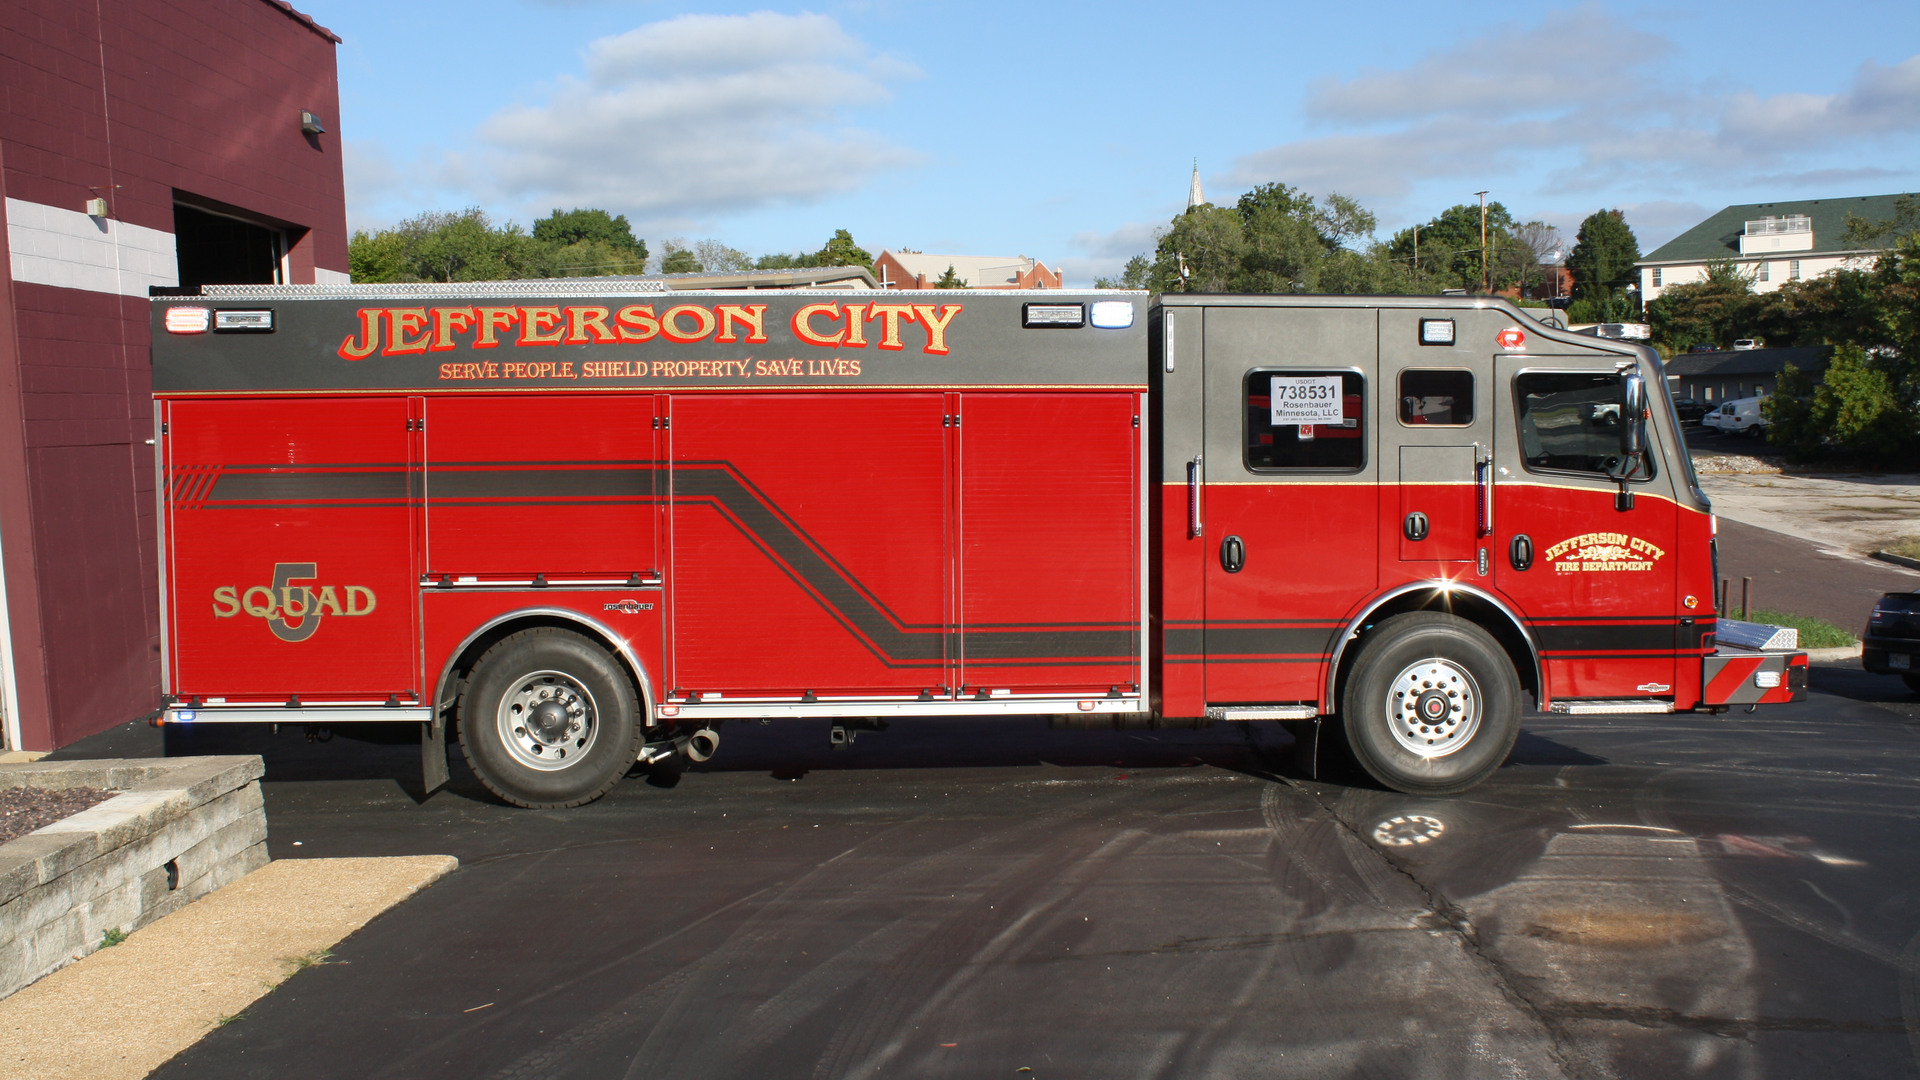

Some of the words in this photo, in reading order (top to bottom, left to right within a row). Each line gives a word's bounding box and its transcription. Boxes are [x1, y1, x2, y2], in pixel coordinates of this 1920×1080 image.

[338, 304, 768, 361] JEFFERSON
[791, 301, 964, 356] CITY
[438, 360, 499, 380] SERVE
[502, 361, 578, 380] PEOPLE,
[581, 361, 648, 379] SHIELD
[650, 359, 751, 379] PROPERTY,
[754, 358, 804, 377] SAVE
[807, 358, 862, 377] LIVES
[1278, 385, 1335, 399] 738531
[1275, 409, 1321, 418] Minnesota,
[1322, 409, 1339, 417] LLC
[1283, 401, 1332, 409] Rosenbauer
[1545, 532, 1629, 562] JEFFERSON
[1630, 536, 1666, 561] CITY
[1555, 561, 1580, 572] FIRE
[1582, 561, 1653, 572] DEPARTMENT
[212, 585, 377, 620] SQUAD
[267, 562, 321, 643] 5
[603, 602, 653, 610] rosenbauer
